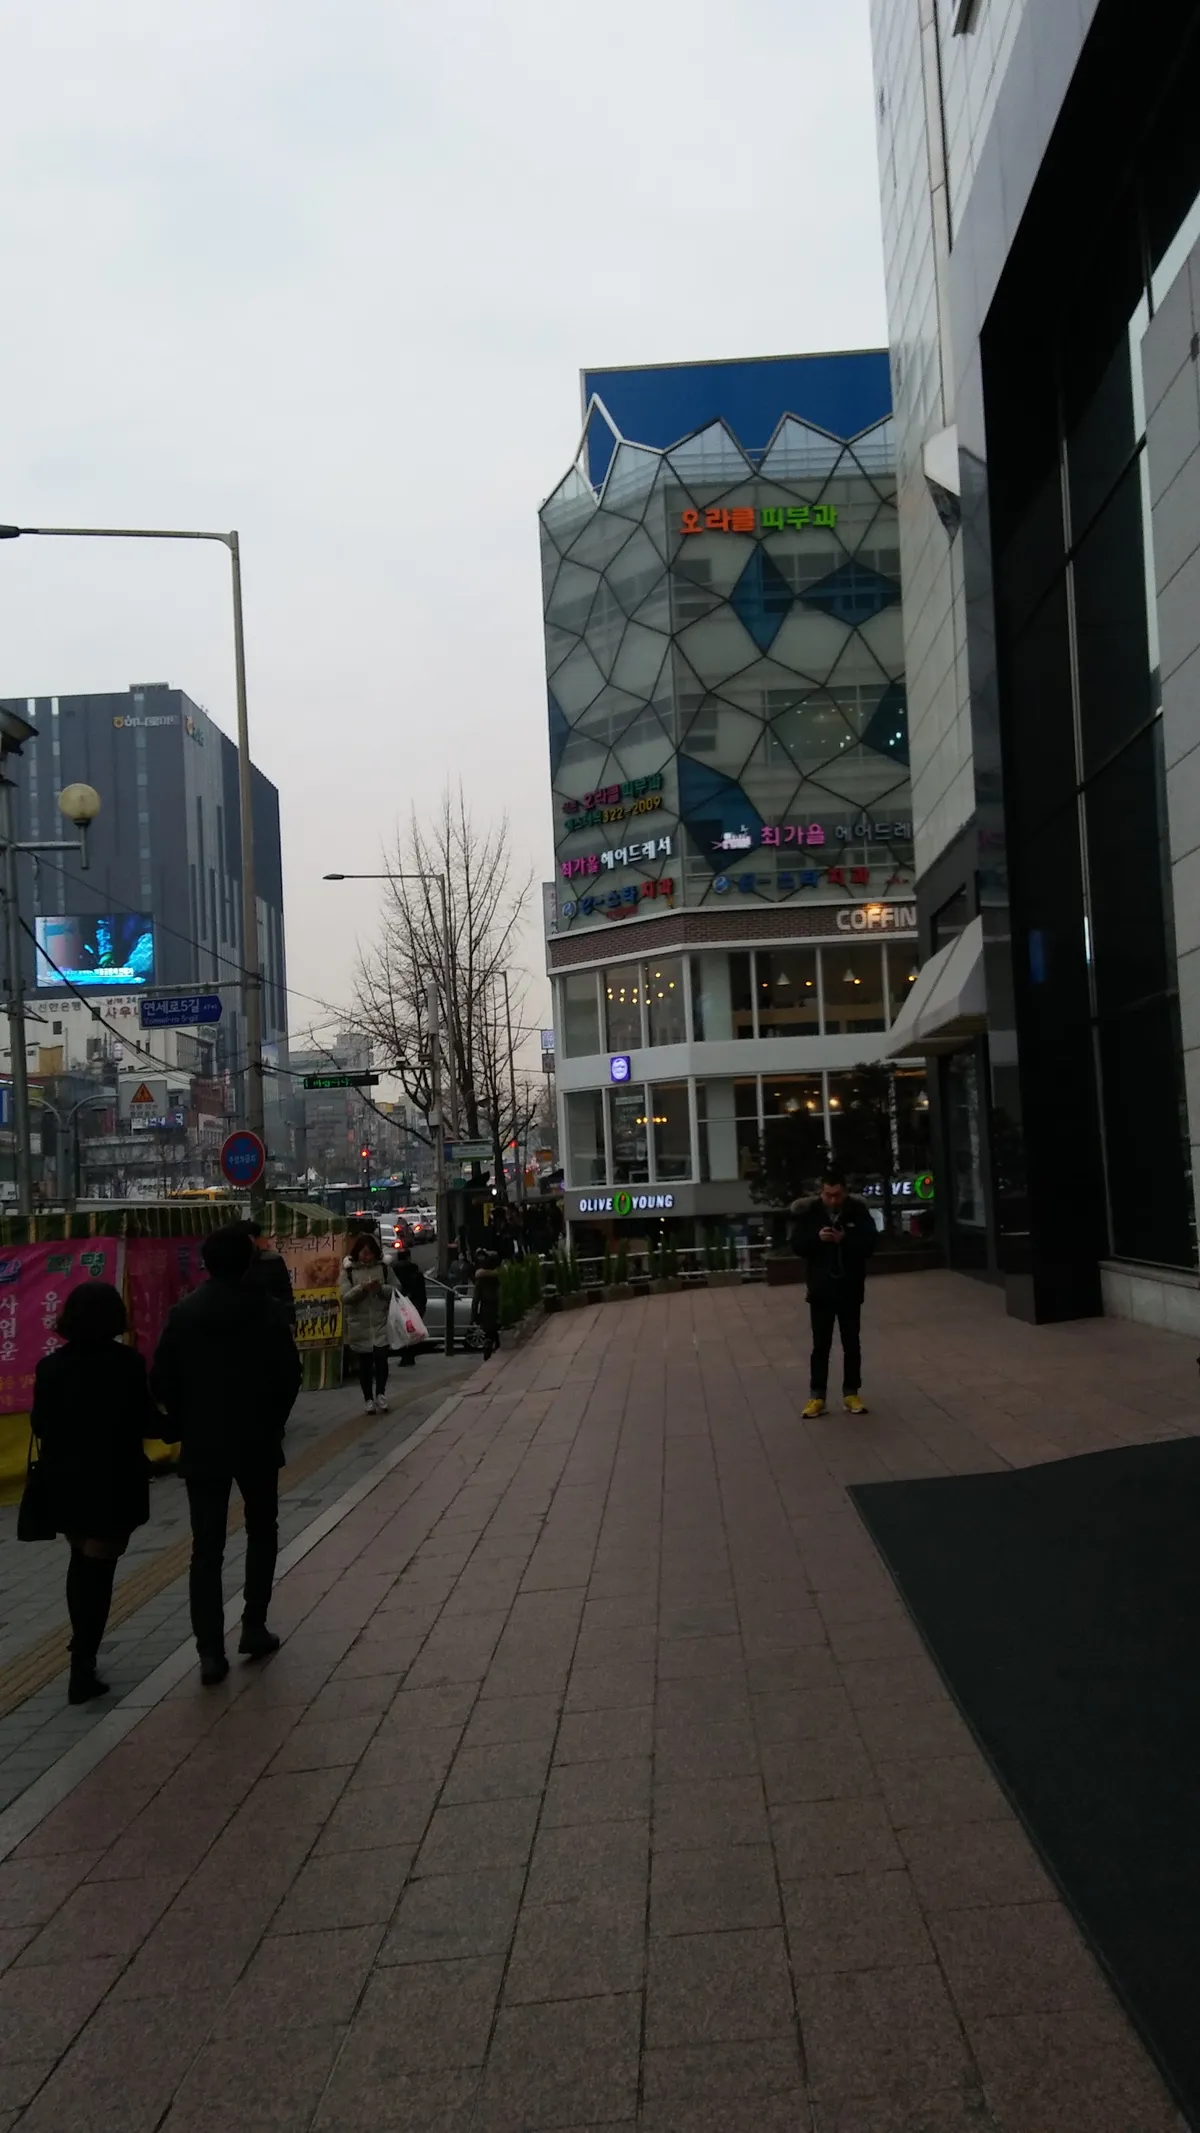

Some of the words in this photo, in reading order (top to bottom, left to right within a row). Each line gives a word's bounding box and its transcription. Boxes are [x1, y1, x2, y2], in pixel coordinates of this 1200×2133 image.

[680, 508, 756, 535] 오라클
[761, 504, 837, 532] 피부과
[760, 823, 826, 848] 최가을
[561, 854, 600, 879] 최가을
[600, 836, 672, 870] 헤어드레서
[836, 906, 917, 931] COFFIN
[143, 999, 200, 1018] 연세로5길
[579, 1198, 614, 1213] OLIVE
[632, 1194, 674, 1210] YOUNG
